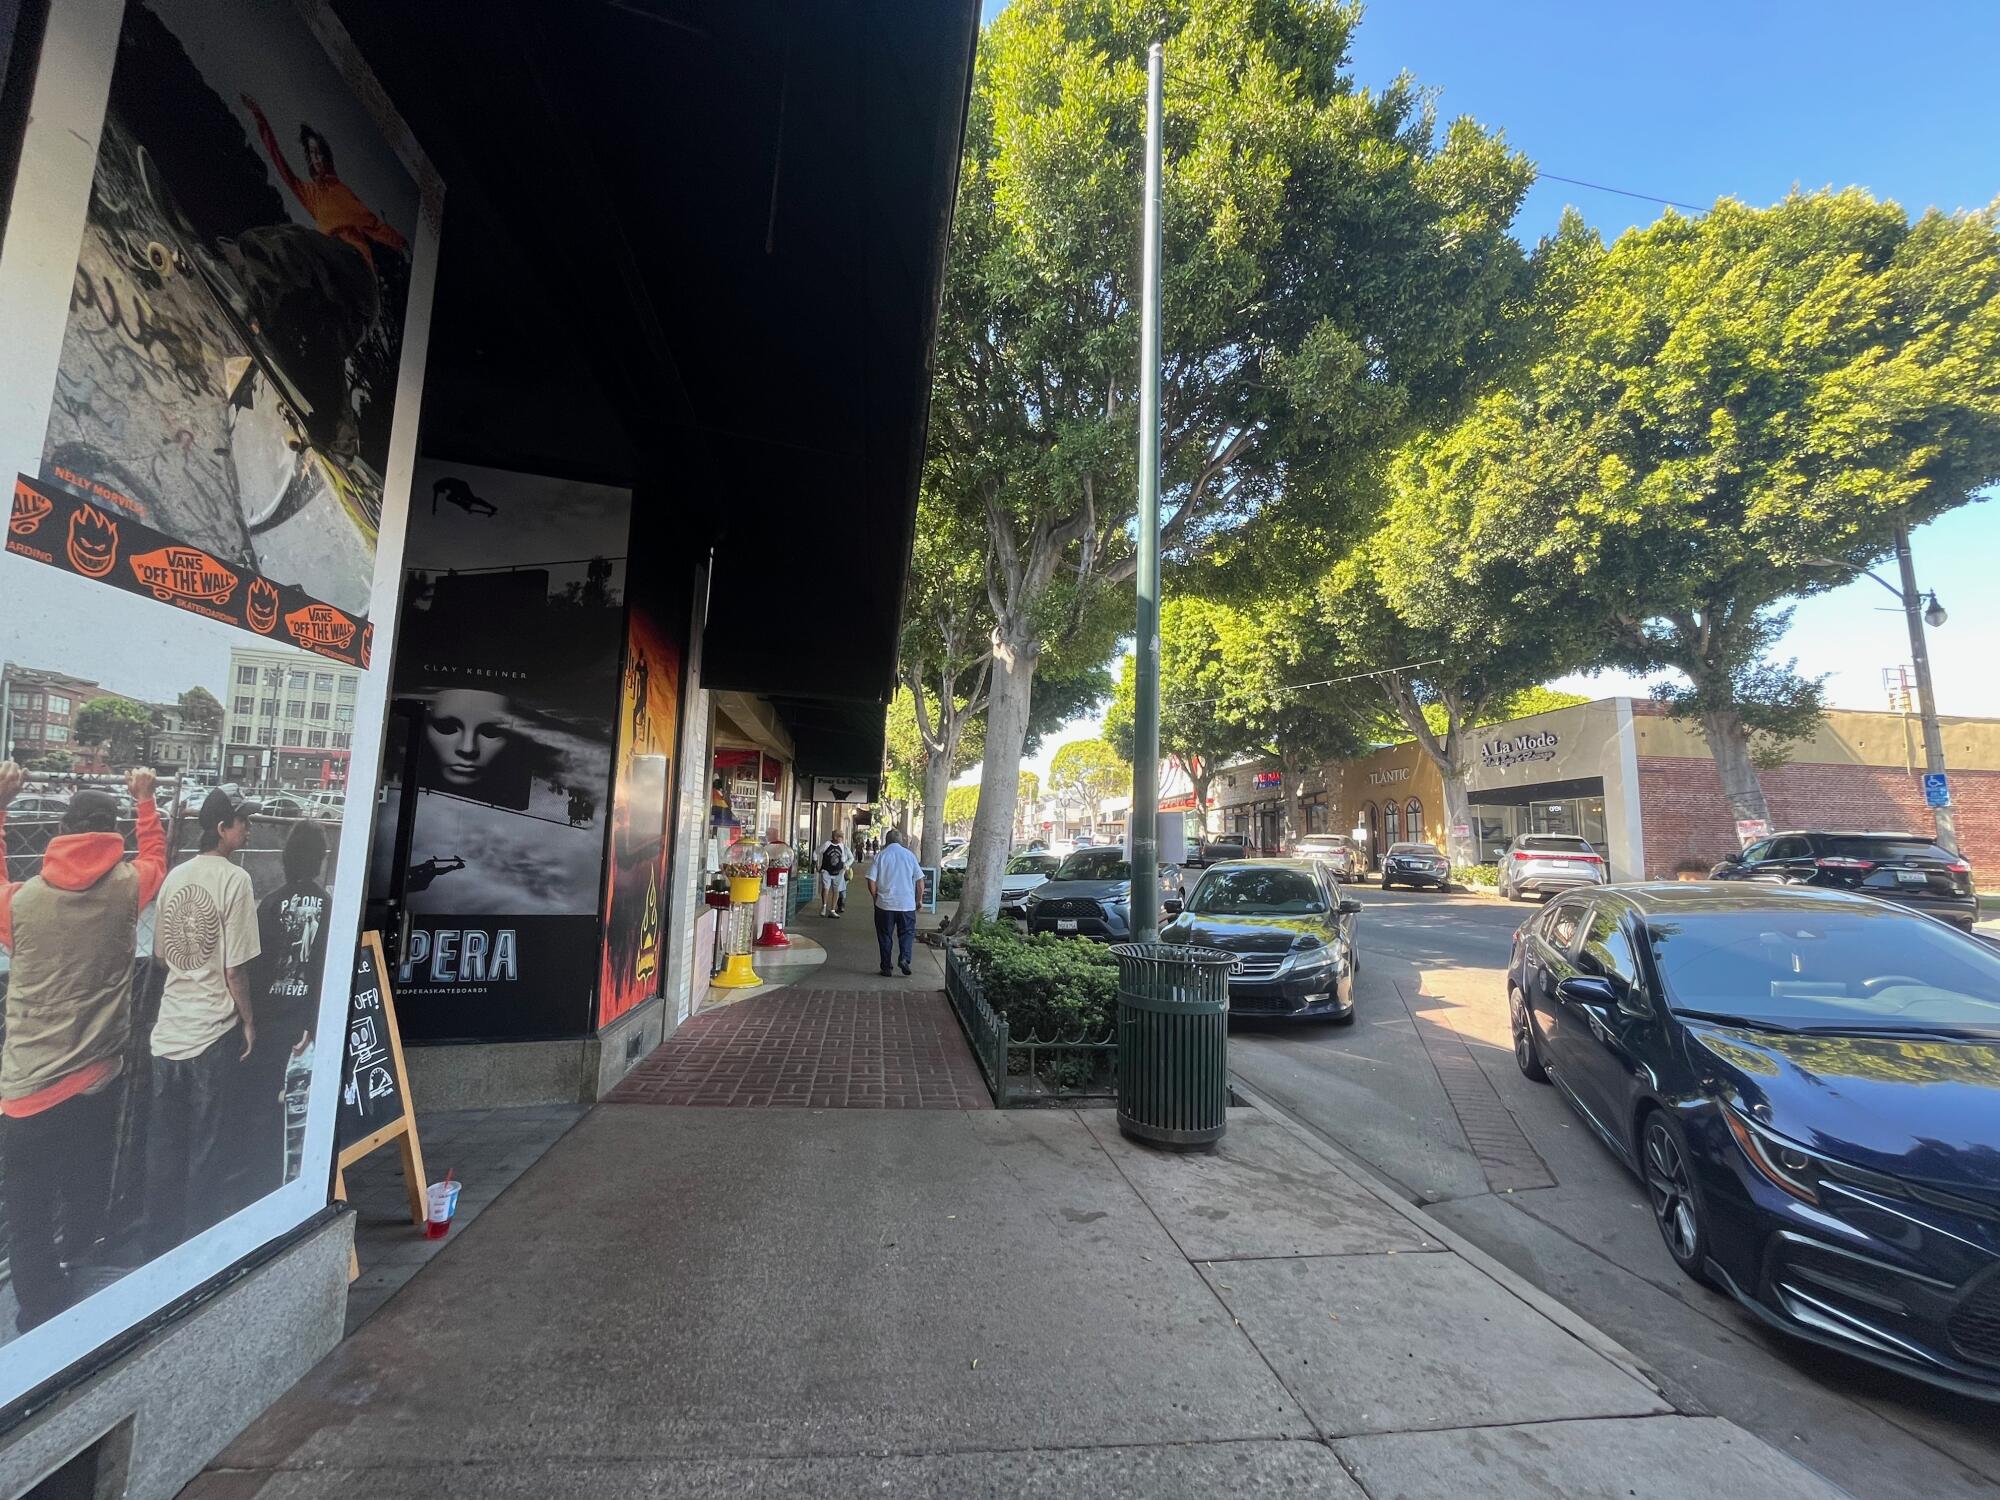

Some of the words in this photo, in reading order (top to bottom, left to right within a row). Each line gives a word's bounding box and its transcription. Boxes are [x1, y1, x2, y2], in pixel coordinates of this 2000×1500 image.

[165, 549, 204, 571] VANS
[170, 568, 199, 593] THE
[175, 598, 239, 625] SKATEBOARDING
[308, 607, 333, 623] VANS
[311, 622, 329, 641] THE
[423, 664, 457, 673] CLAY
[466, 667, 527, 679] KREINER
[1481, 743, 1491, 757] A
[1494, 740, 1512, 755] La
[1515, 731, 1557, 751] Mode
[354, 987, 380, 1010] OFF!
